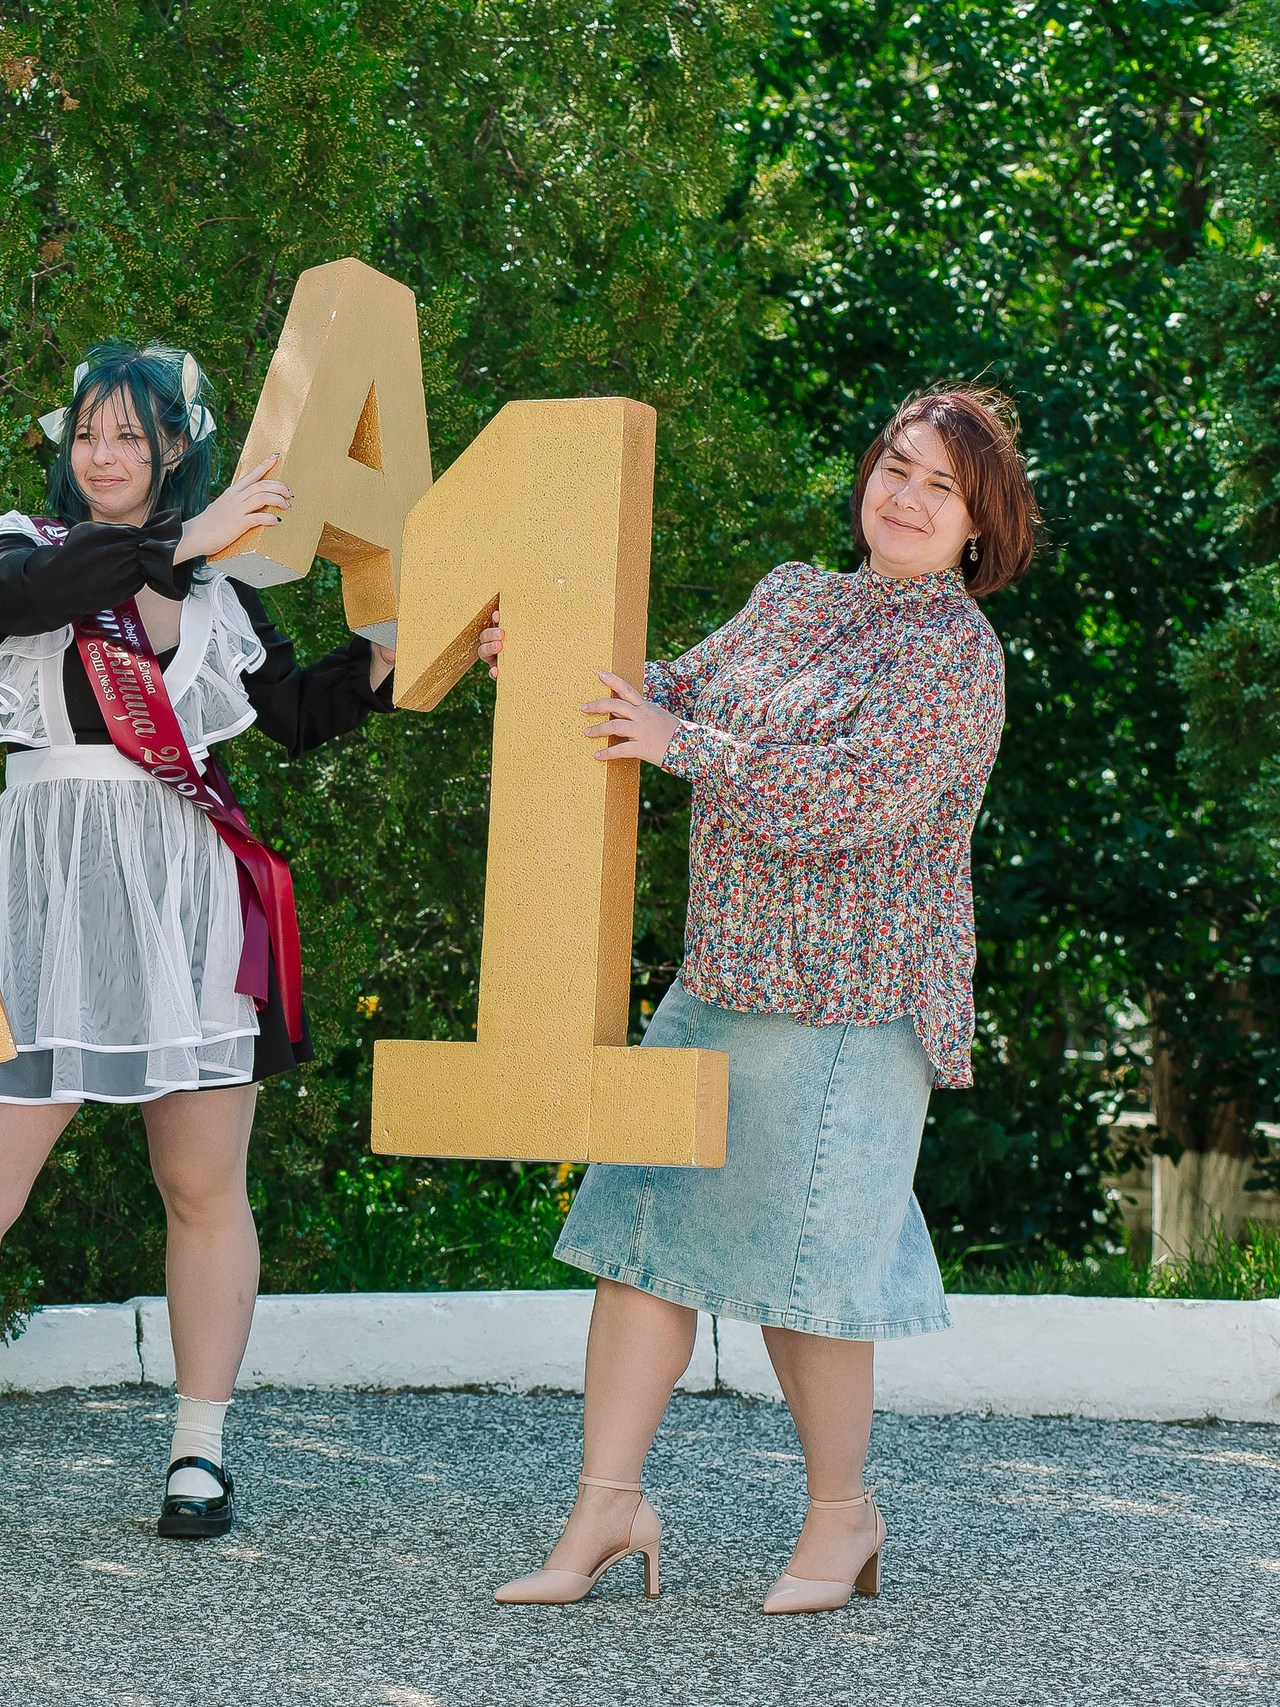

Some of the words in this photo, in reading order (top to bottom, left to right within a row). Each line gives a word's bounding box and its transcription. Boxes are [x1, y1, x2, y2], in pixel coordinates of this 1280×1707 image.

[87, 642, 107, 672] СОШ
[97, 673, 117, 701] №33
[137, 660, 157, 695] Елена
[370, 396, 729, 1169] 1
